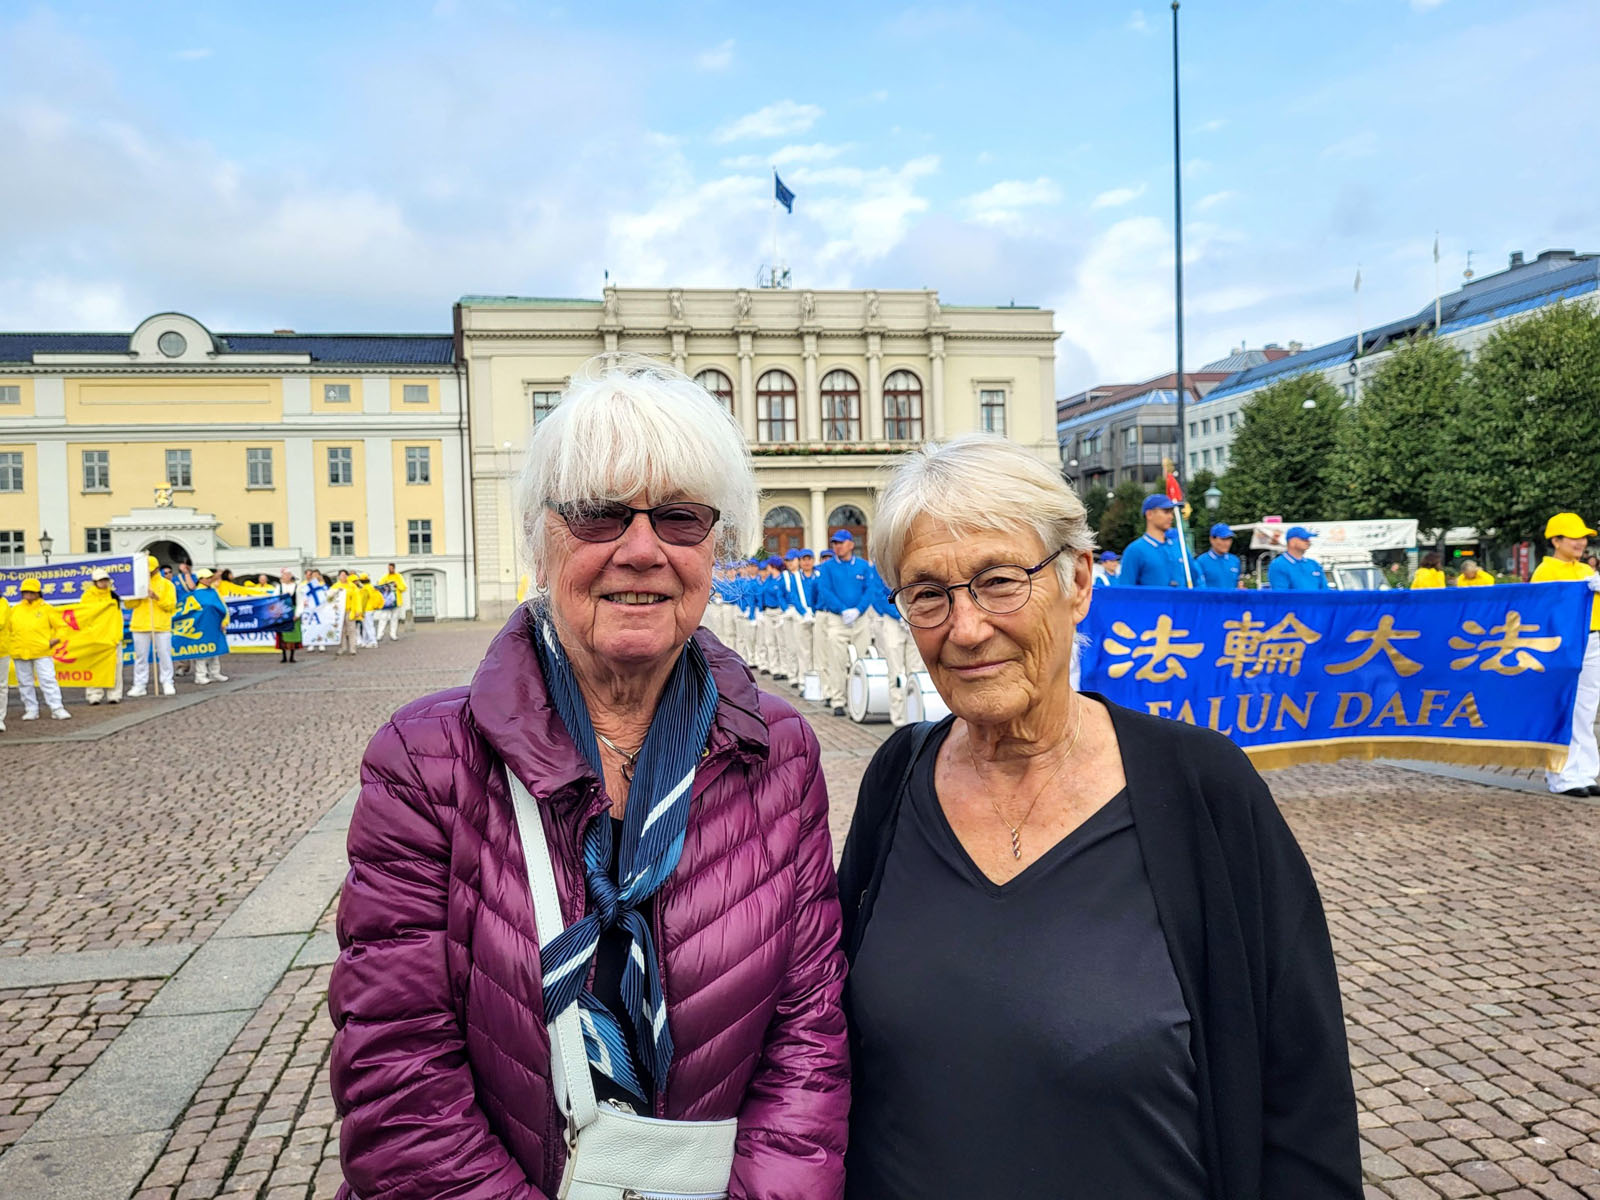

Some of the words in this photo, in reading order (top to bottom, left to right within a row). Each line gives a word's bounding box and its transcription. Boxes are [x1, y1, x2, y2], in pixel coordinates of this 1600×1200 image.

[1103, 610, 1562, 683] 法輪大法
[1330, 689, 1488, 730] DAFA
